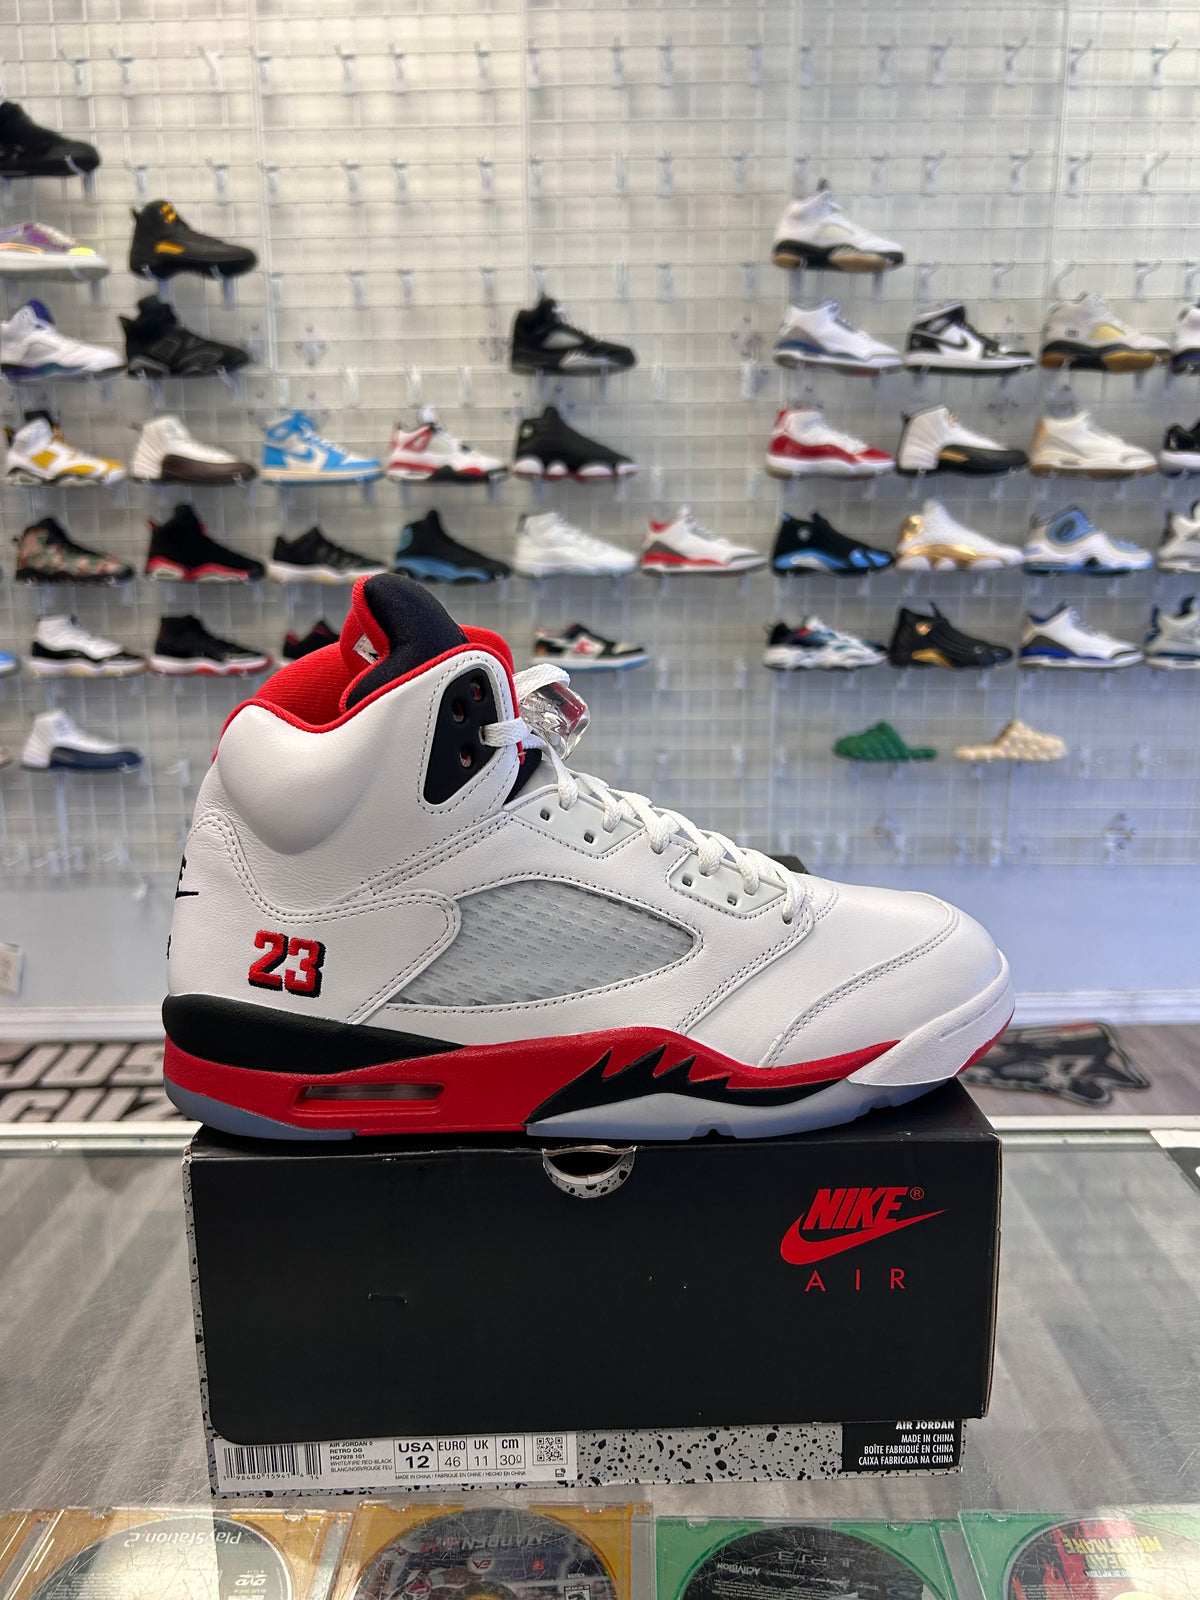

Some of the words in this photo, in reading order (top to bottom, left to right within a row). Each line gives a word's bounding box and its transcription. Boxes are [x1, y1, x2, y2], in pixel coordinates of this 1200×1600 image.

[248, 930, 326, 998] 23
[804, 1268, 906, 1292] AIR
[896, 1421, 913, 1430] AIR
[915, 1420, 955, 1430] JORDAN
[901, 1434, 921, 1443] MADE
[923, 1434, 931, 1443] IN
[932, 1433, 955, 1443] CHINA
[399, 1442, 434, 1453] USA
[438, 1440, 466, 1451] EURO
[474, 1439, 489, 1450] UK
[501, 1438, 519, 1449] cm
[864, 1443, 884, 1455] BOÎTE
[885, 1443, 920, 1455] FABRIQUÉ
[921, 1444, 931, 1453] EN
[932, 1444, 954, 1453] CHINA
[405, 1455, 430, 1468] 12
[444, 1456, 461, 1467] 46
[474, 1455, 488, 1466] 11
[858, 1456, 879, 1466] CAIXA
[880, 1455, 919, 1465] FABRICADA
[920, 1455, 931, 1464] NA
[931, 1454, 954, 1464] CHINA
[145, 1530, 242, 1546] PlayStation
[1065, 1537, 1162, 1554] NIGHTMARE
